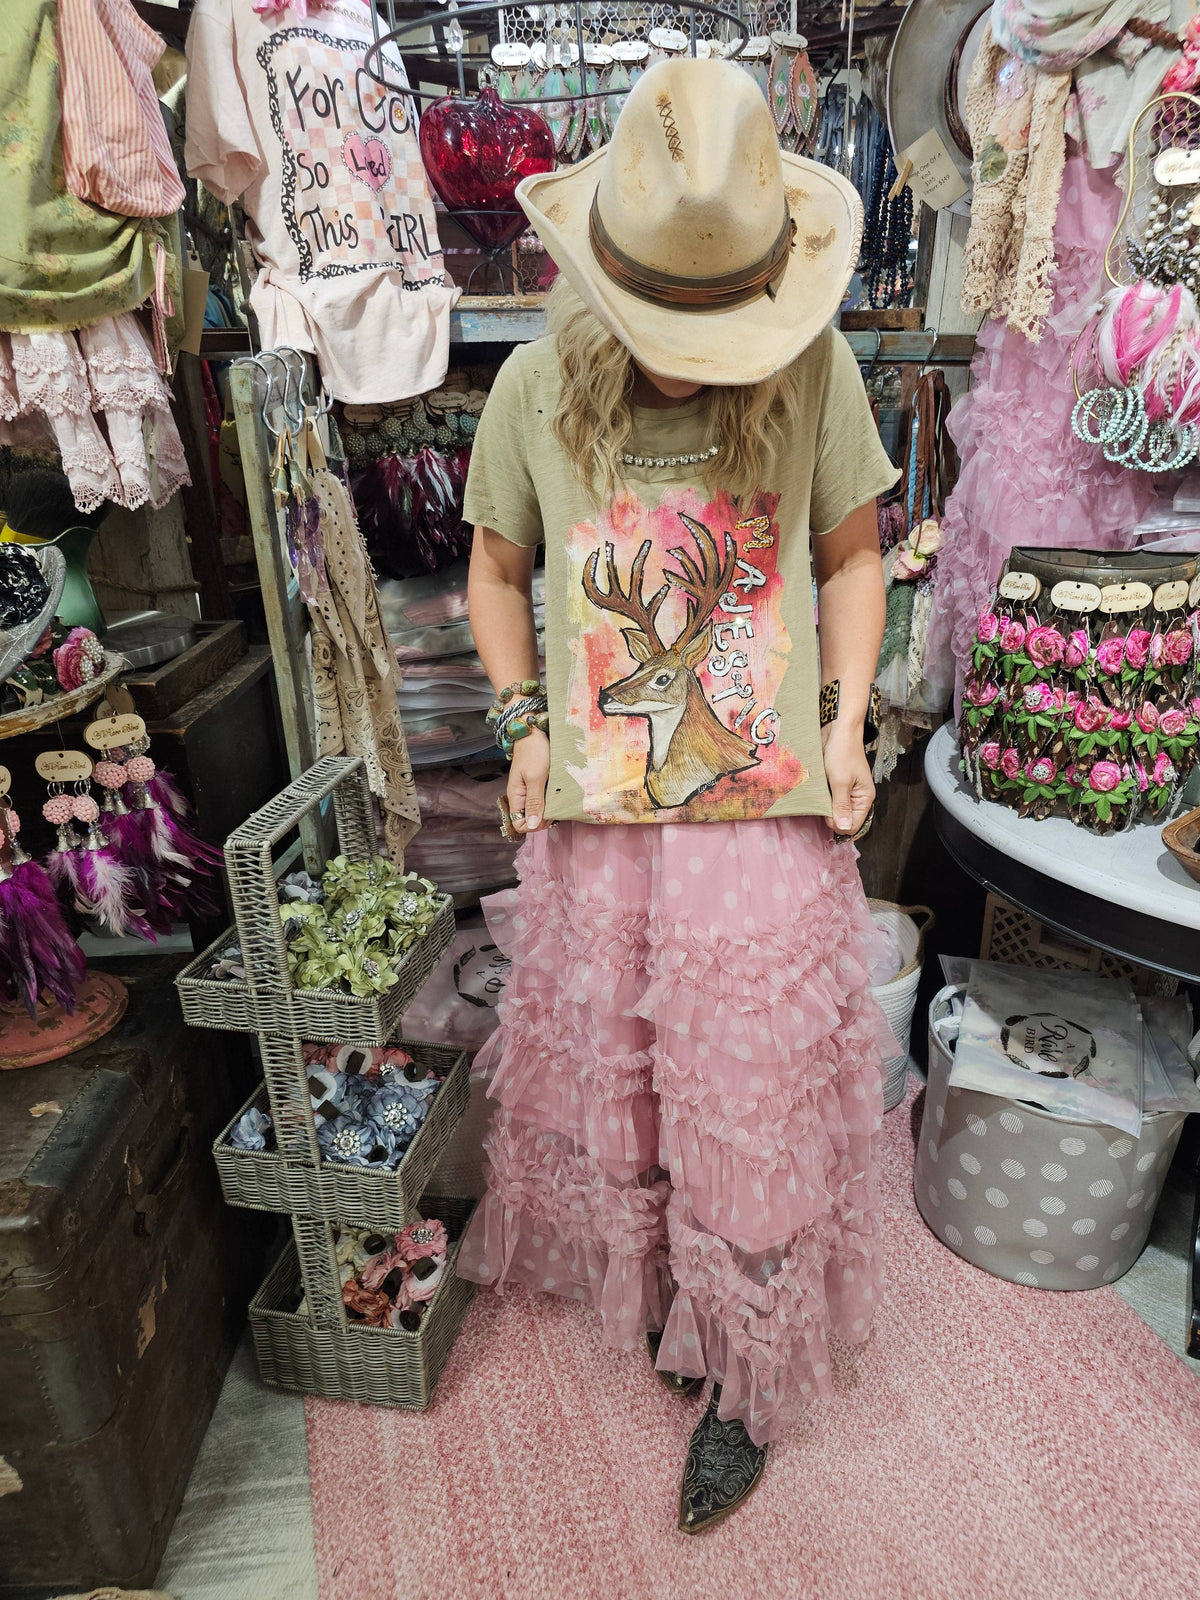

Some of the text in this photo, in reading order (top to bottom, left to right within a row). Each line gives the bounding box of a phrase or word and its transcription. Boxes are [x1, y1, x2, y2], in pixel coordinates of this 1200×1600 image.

[286, 65, 344, 132] For
[296, 152, 330, 192] So
[299, 203, 359, 253] This
[708, 515, 780, 746] MAJESTIC
[1025, 1028, 1036, 1053] BIRD
[1038, 1021, 1068, 1063] Rare
